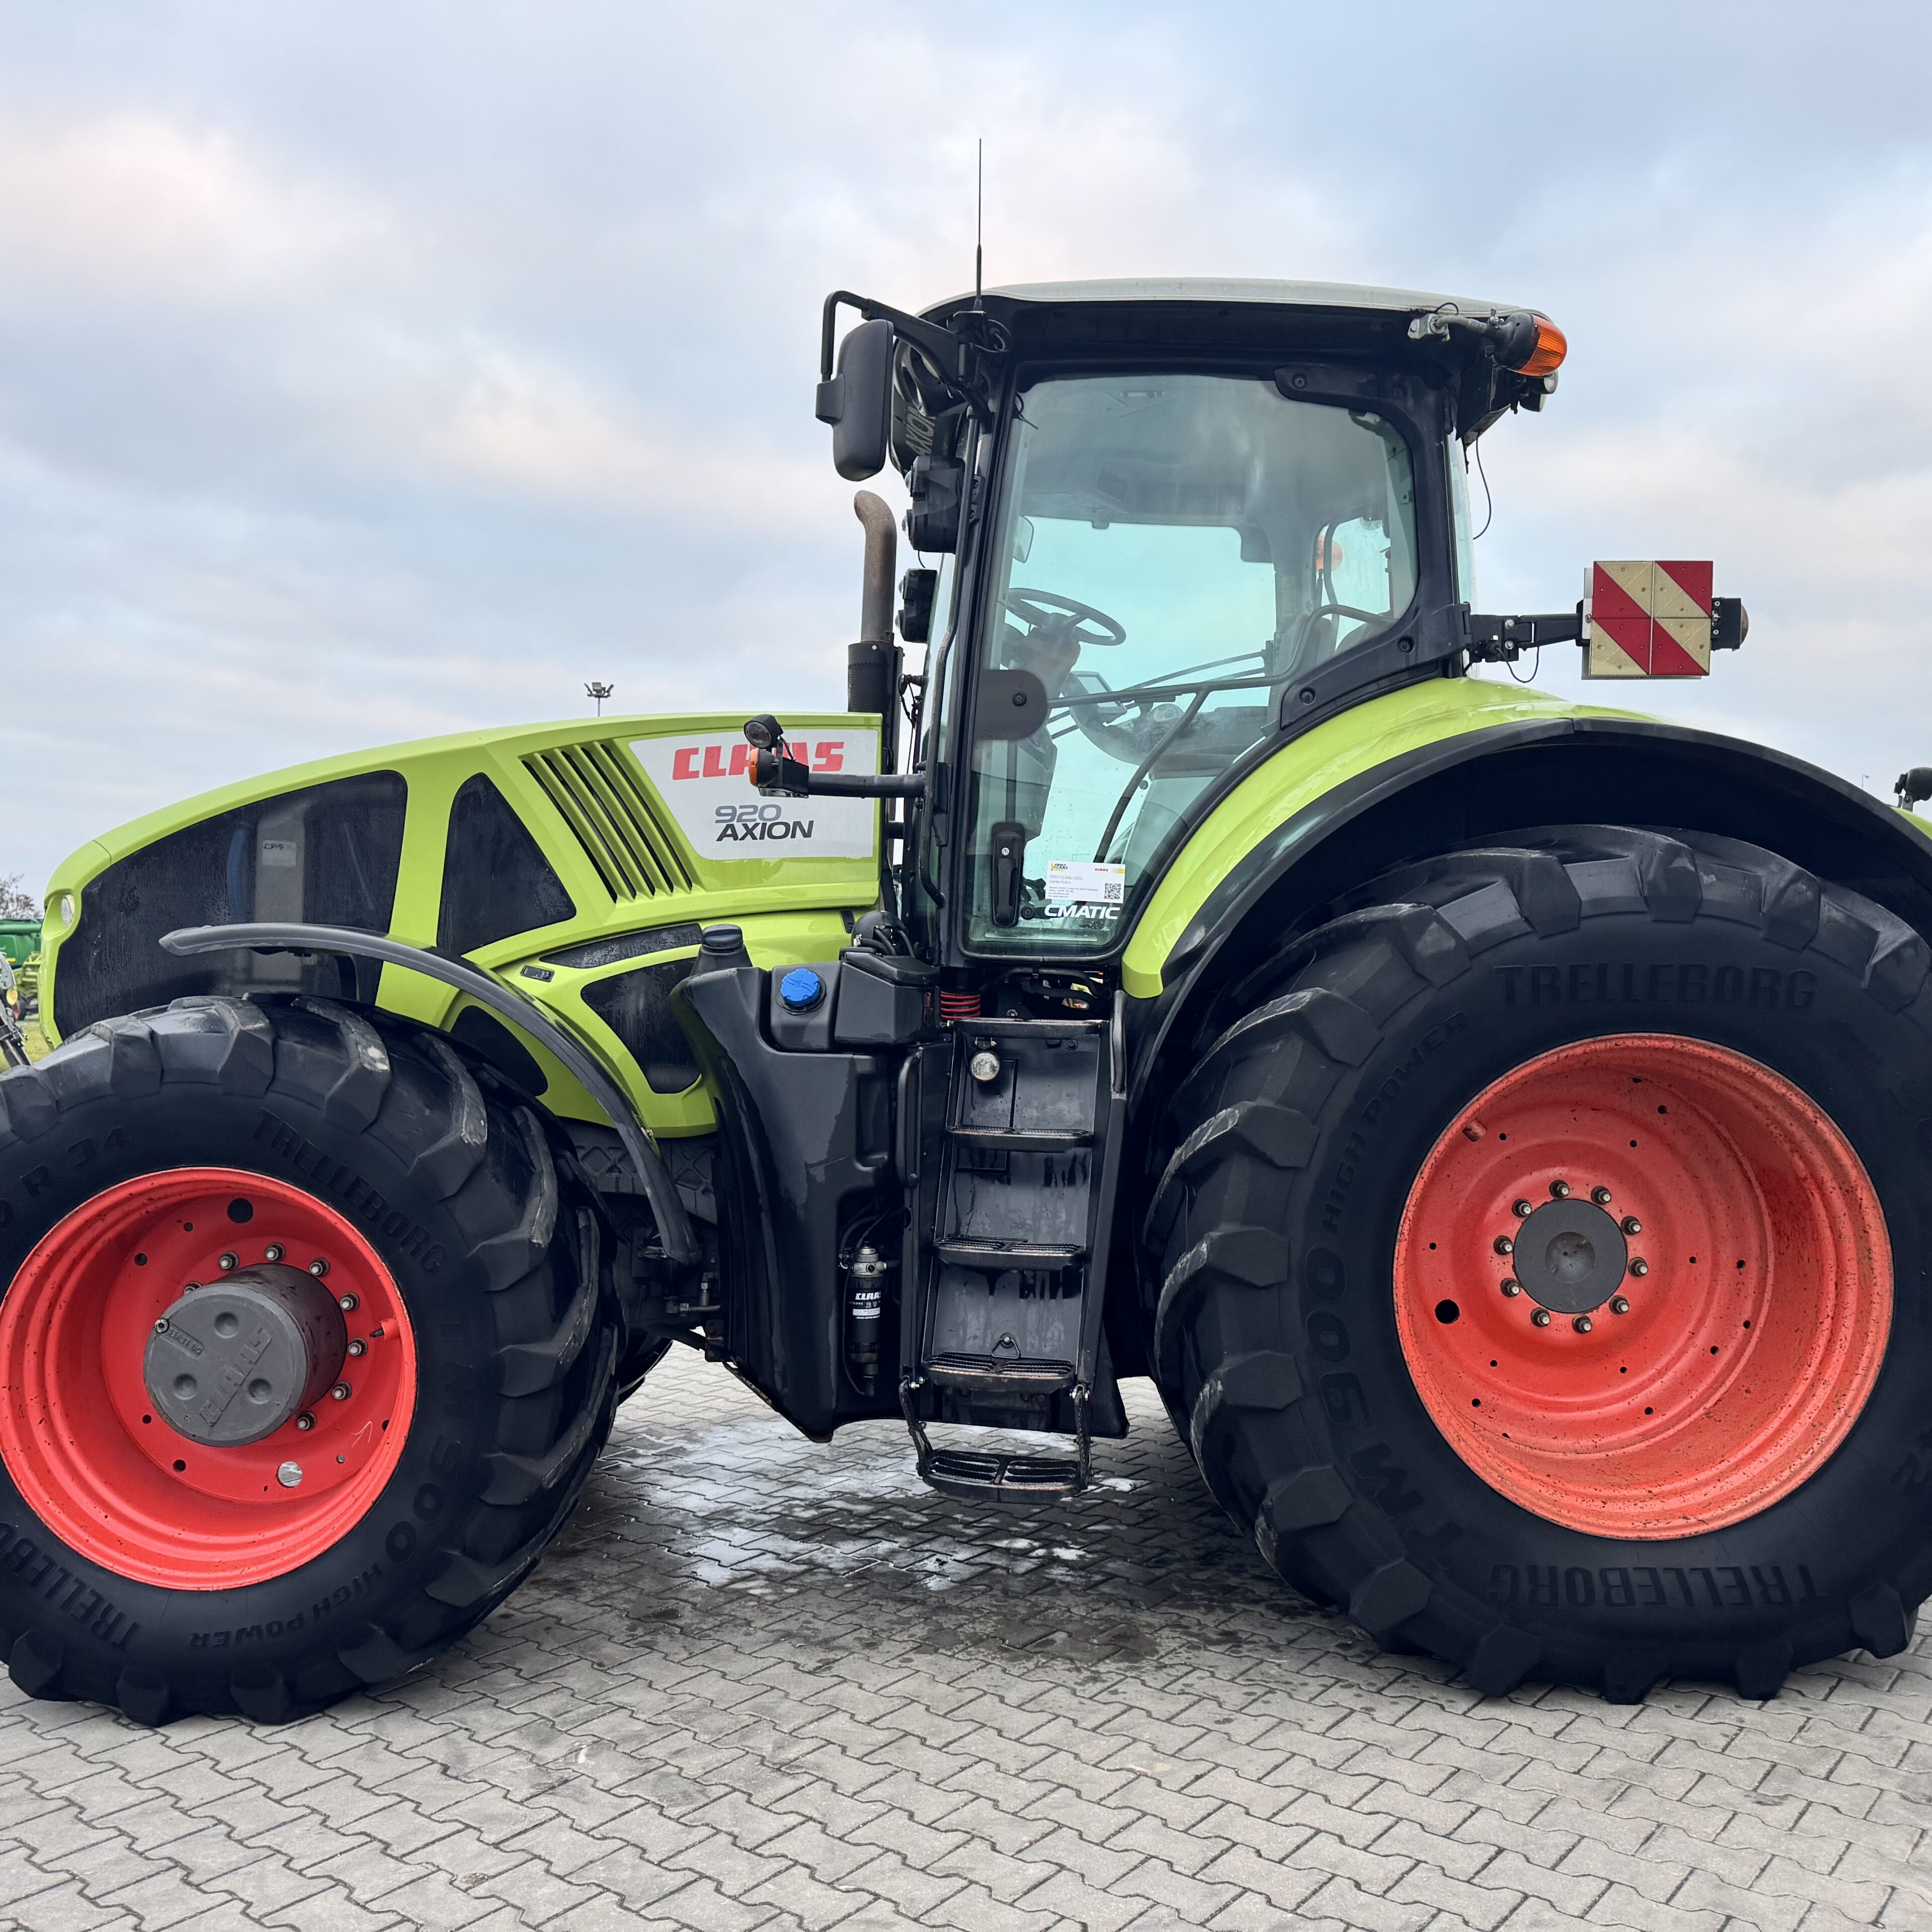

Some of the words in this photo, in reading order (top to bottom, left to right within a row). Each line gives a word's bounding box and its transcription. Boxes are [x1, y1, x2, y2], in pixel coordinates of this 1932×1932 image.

[715, 804, 782, 824] 920
[716, 820, 814, 842] AXION
[1044, 904, 1120, 919] CMATIC
[1493, 963, 1817, 1009] TRELLEBORG
[1321, 1131, 1366, 1233] HIGH
[1362, 1010, 1469, 1125] POWER
[253, 1107, 449, 1273] TRELLEBORG
[1305, 1244, 1371, 1426] 900
[312, 1563, 382, 1619] HIGH
[1487, 1563, 1827, 1609] TRELLEBORG
[189, 1612, 305, 1648] POWER
